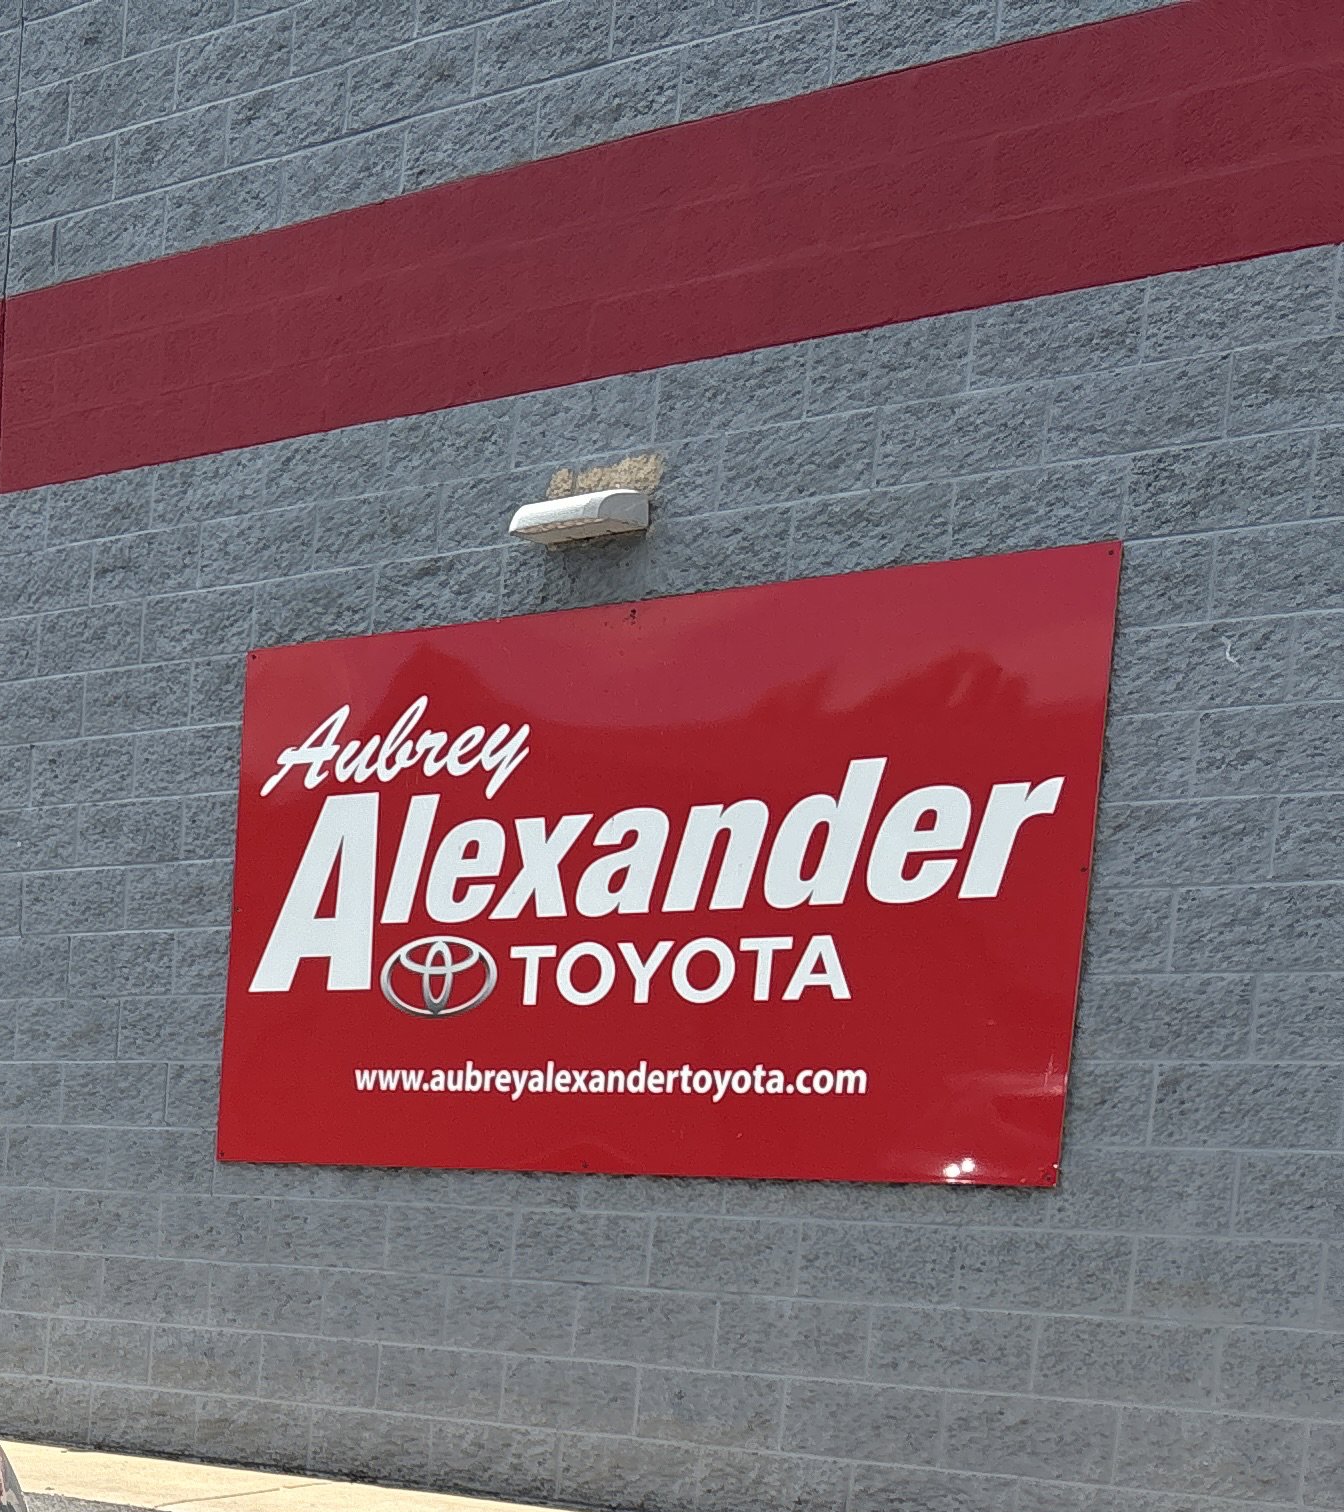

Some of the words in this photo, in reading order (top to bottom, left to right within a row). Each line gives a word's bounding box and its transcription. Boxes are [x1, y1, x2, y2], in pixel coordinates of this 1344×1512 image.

[261, 695, 530, 800] Aubrey
[248, 757, 1065, 993] Alexander
[511, 935, 852, 1006] TOYOTA
[355, 1060, 867, 1103] www.aubreyalexandertoyota.com
